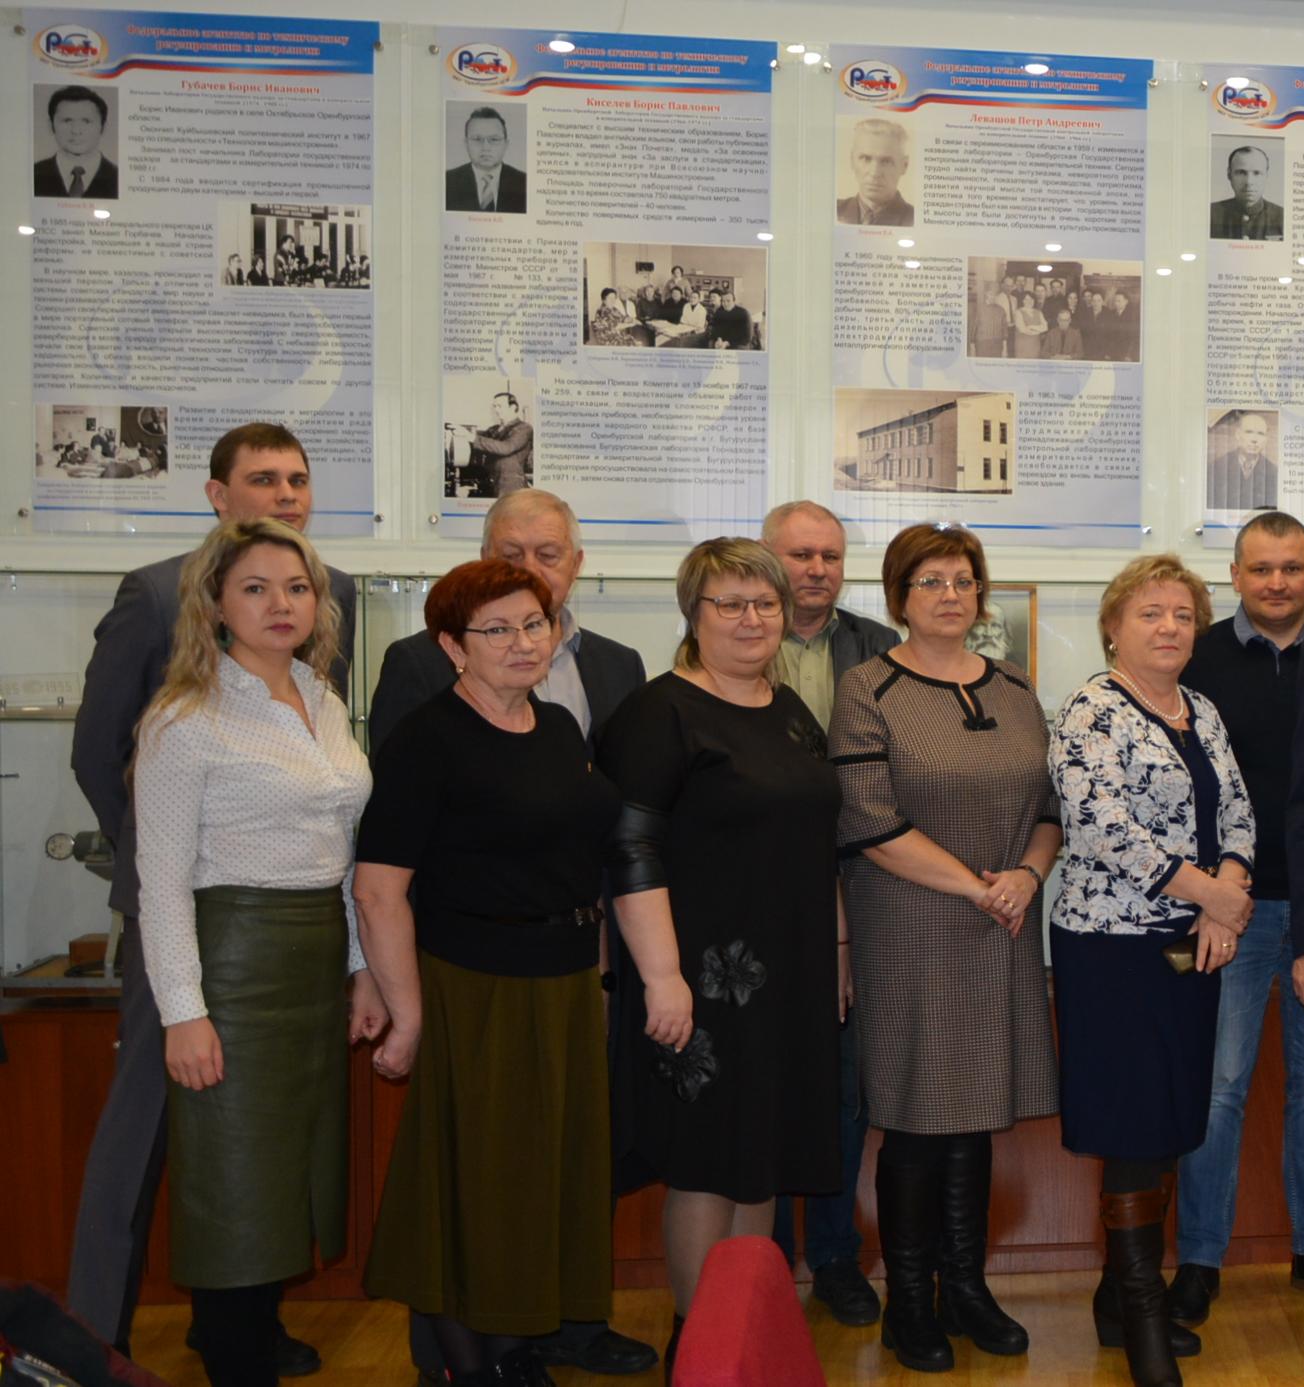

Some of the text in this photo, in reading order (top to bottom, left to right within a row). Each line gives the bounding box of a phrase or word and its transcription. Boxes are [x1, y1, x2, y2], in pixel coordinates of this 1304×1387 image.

[182, 79, 320, 94] Губачев Борис Иванович
[587, 96, 720, 112] Киселев Борис Павлович
[970, 113, 1103, 128] Левашов Петр Андреевич
